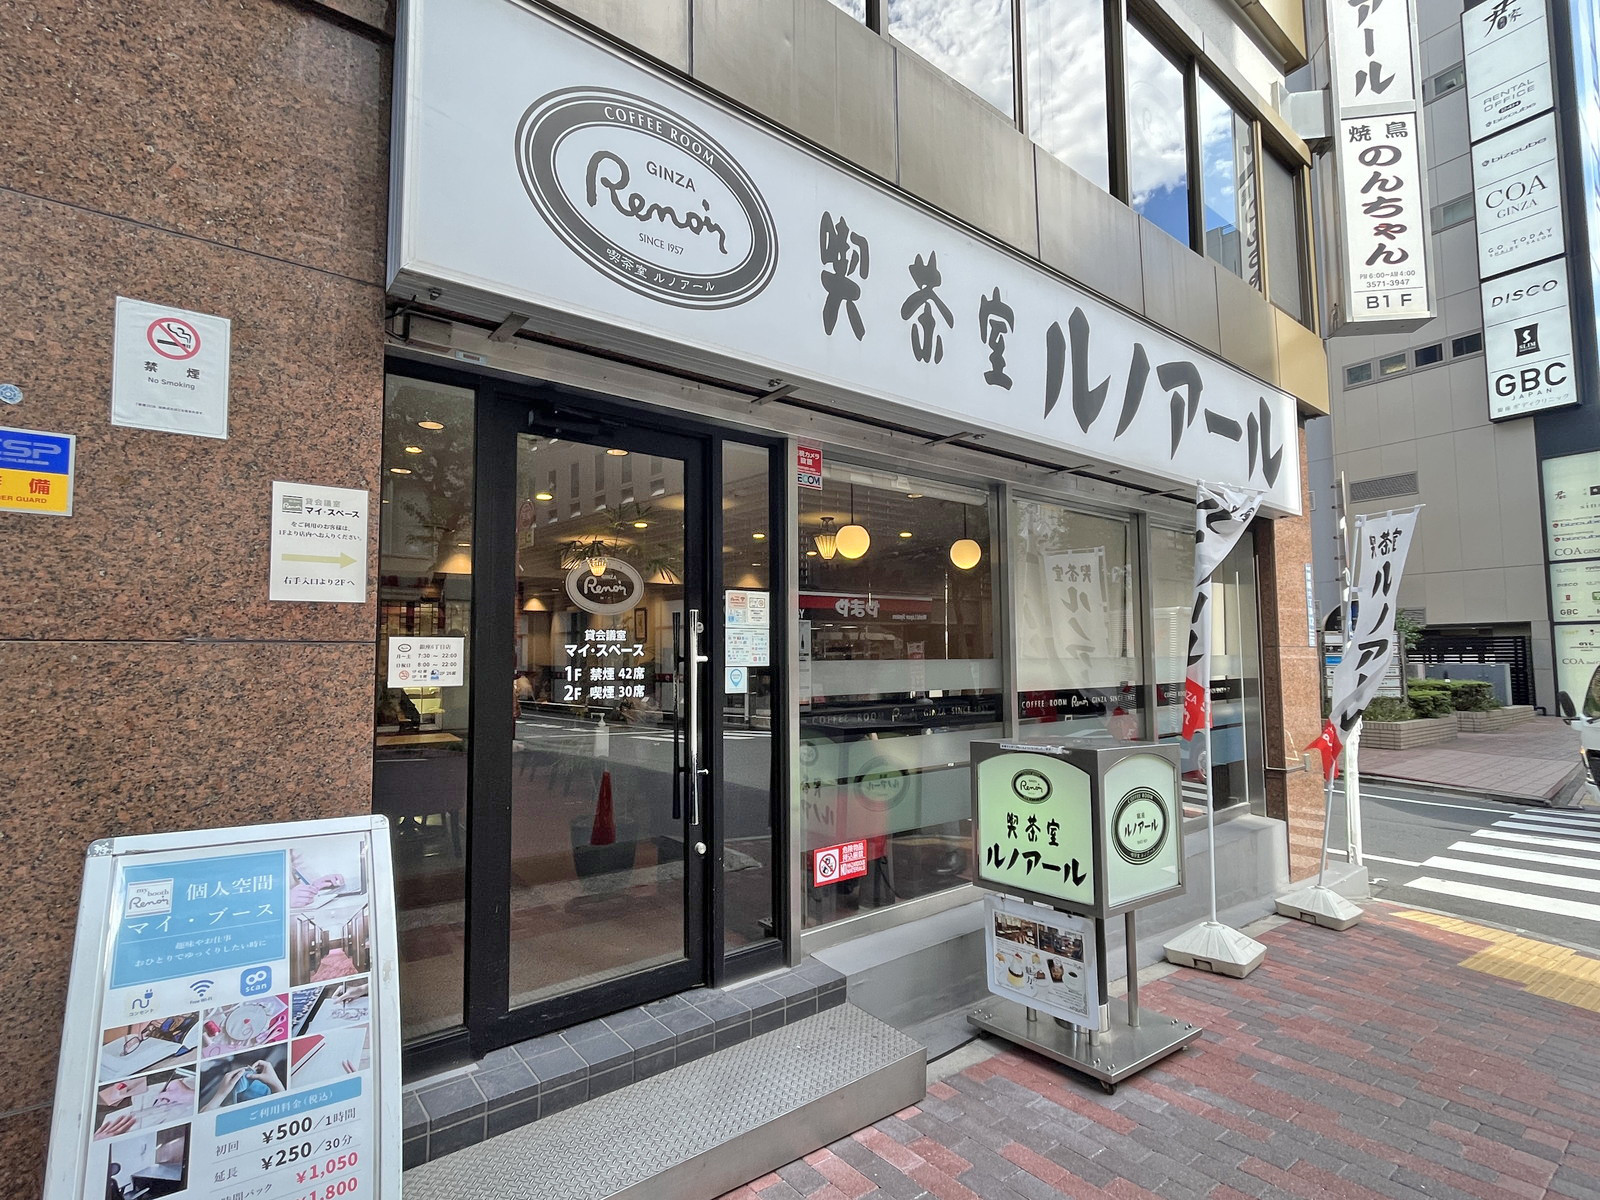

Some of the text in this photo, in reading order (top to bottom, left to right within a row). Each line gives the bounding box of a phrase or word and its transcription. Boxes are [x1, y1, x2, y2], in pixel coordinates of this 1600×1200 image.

[1484, 80, 1534, 105] RENTAL
[1484, 85, 1534, 112] OFFICE
[604, 106, 715, 165] COFFEE ROOM
[1349, 121, 1408, 142] 焼鳥
[1491, 138, 1546, 163] bizcube
[646, 161, 696, 192] GINZA
[1485, 174, 1548, 209] COA
[586, 150, 728, 255] Renoir
[1358, 144, 1409, 266] のんちゃん
[1497, 199, 1538, 219] GINZA
[638, 232, 684, 255] SINCE 1957
[1488, 227, 1552, 254] GO TODAY
[606, 248, 716, 291] 喫茶室 ルノアール
[1366, 279, 1410, 288] 3571-3947
[1491, 280, 1558, 308] DISCO
[144, 361, 200, 380] 禁煙
[1495, 362, 1567, 397] GBC
[161, 379, 195, 391] Smoking
[1512, 388, 1552, 401] JAPAN
[0, 438, 62, 459] SP
[16, 496, 47, 504] GUARD
[305, 497, 341, 508] 貸会議室
[1554, 547, 1582, 556] COA
[583, 576, 627, 596] Renoir
[1560, 608, 1578, 616] GBC
[584, 630, 626, 641] 貸会議室
[564, 644, 645, 657] マイ・スペース
[565, 666, 645, 681] 1F 禁煙 42席
[563, 685, 645, 700] 2F 喫煙 30席
[1021, 700, 1045, 709] COFFEE
[1049, 698, 1068, 707] ROOM
[1007, 812, 1060, 847] 喫茶室
[1124, 819, 1158, 838] ルノアール
[987, 842, 1088, 887] ルノアール
[186, 874, 273, 901] 個人空間
[129, 895, 169, 910] Renoir
[128, 904, 273, 934] マイ・ブース
[245, 983, 267, 992] scan
[216, 1140, 239, 1157] 初回
[213, 1166, 238, 1183] 延長
[296, 1152, 358, 1184] ¥1,050
[296, 1177, 358, 1200] 1,800
